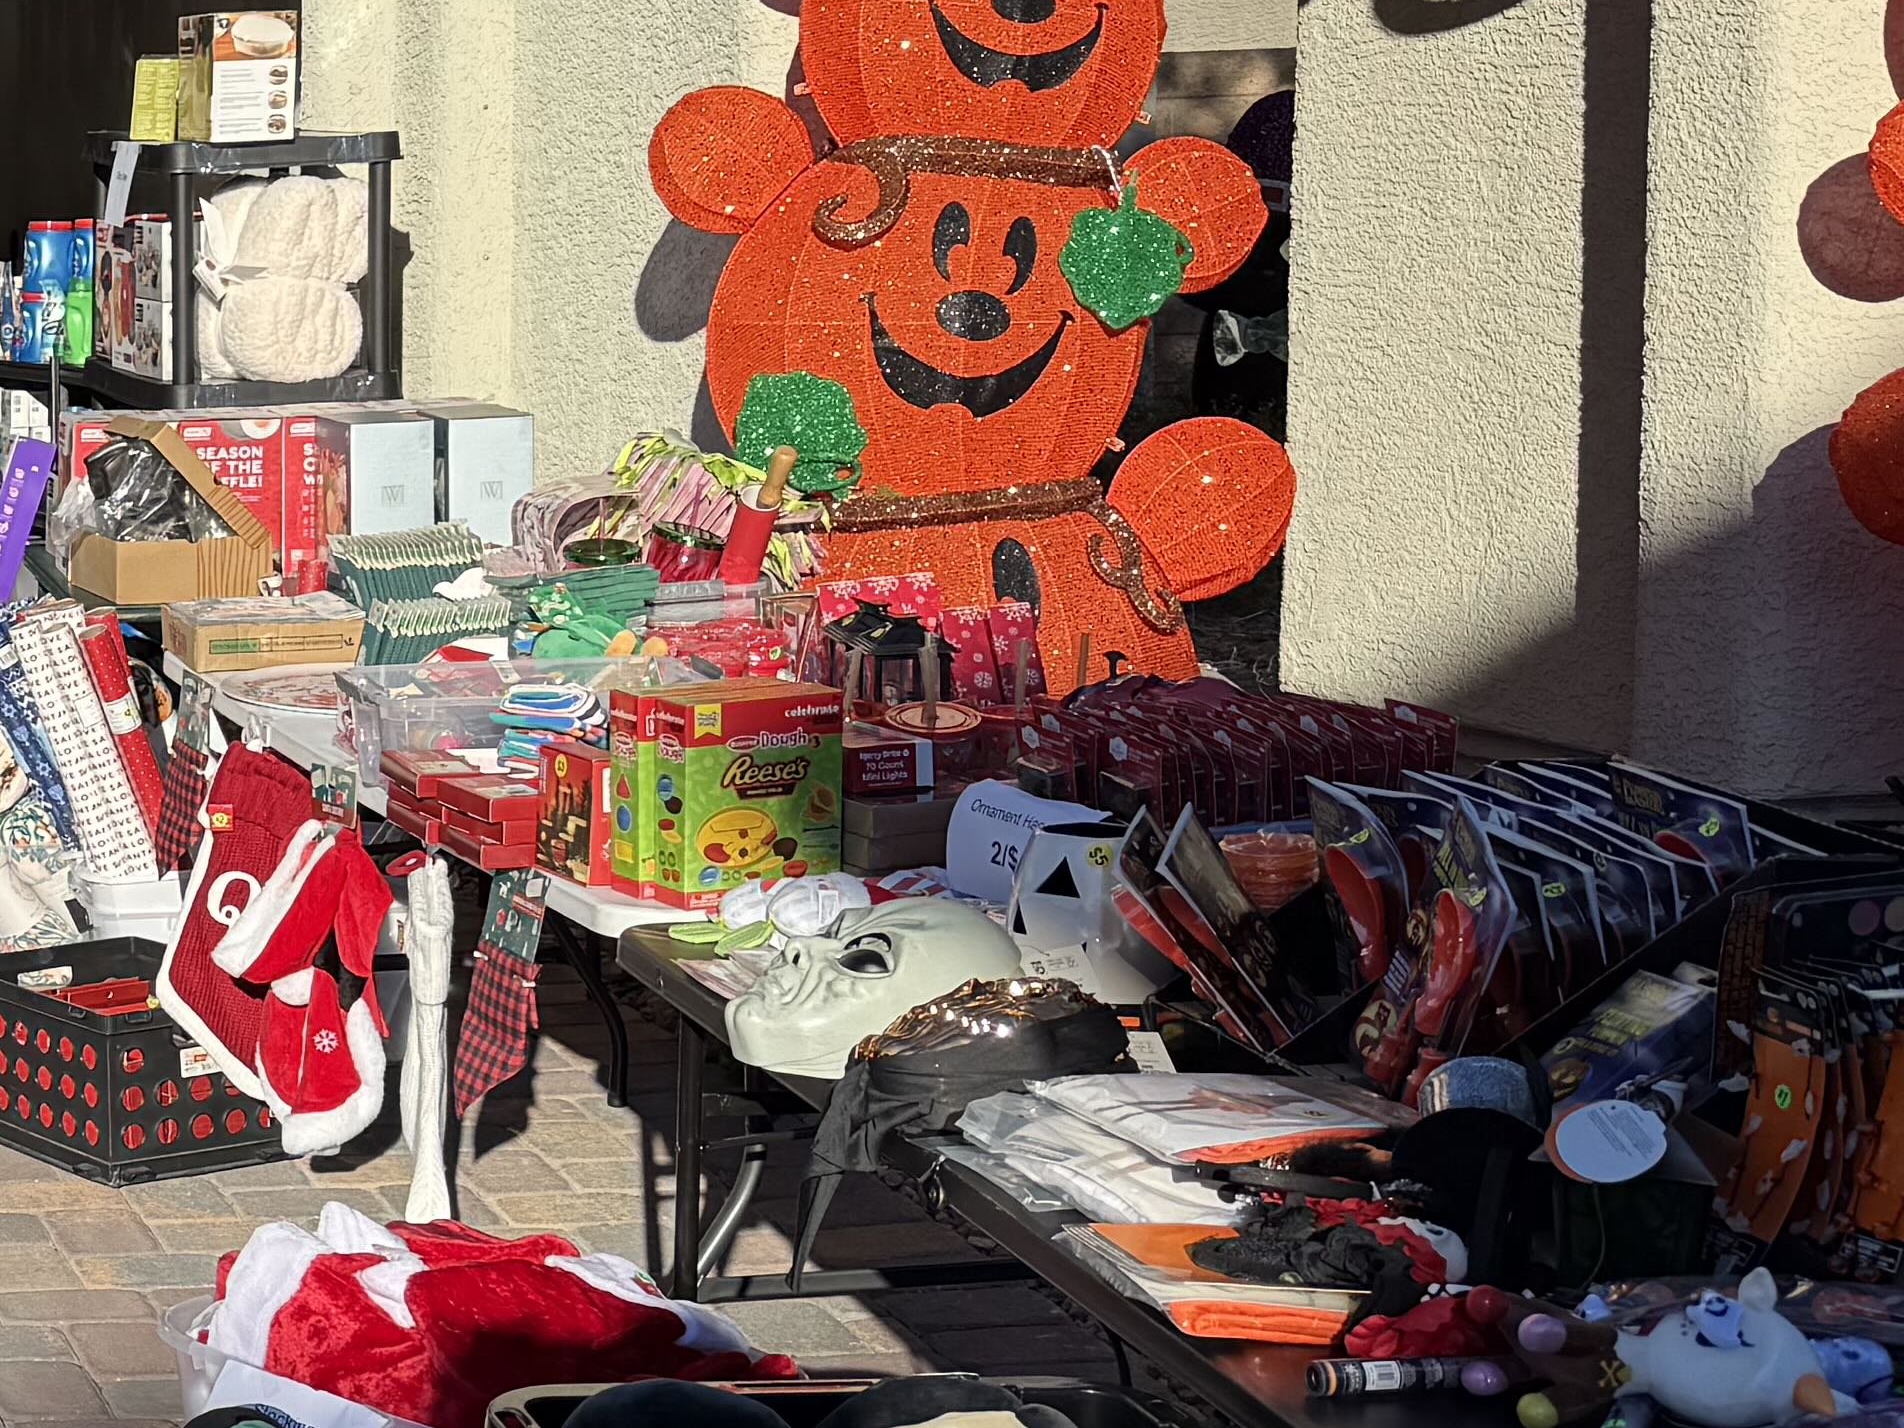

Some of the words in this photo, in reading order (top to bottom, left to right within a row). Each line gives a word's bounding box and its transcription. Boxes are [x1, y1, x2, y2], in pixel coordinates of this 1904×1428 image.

[196, 445, 264, 460] SEASON
[225, 460, 263, 474] THE
[220, 474, 263, 488] FFLE!
[784, 704, 840, 718] celebrate
[760, 726, 809, 750] Dough
[722, 755, 809, 788] Reese's
[862, 772, 880, 781] Mini
[882, 771, 908, 781] Lights
[971, 798, 1023, 826] Ornament
[1089, 846, 1109, 866] $5
